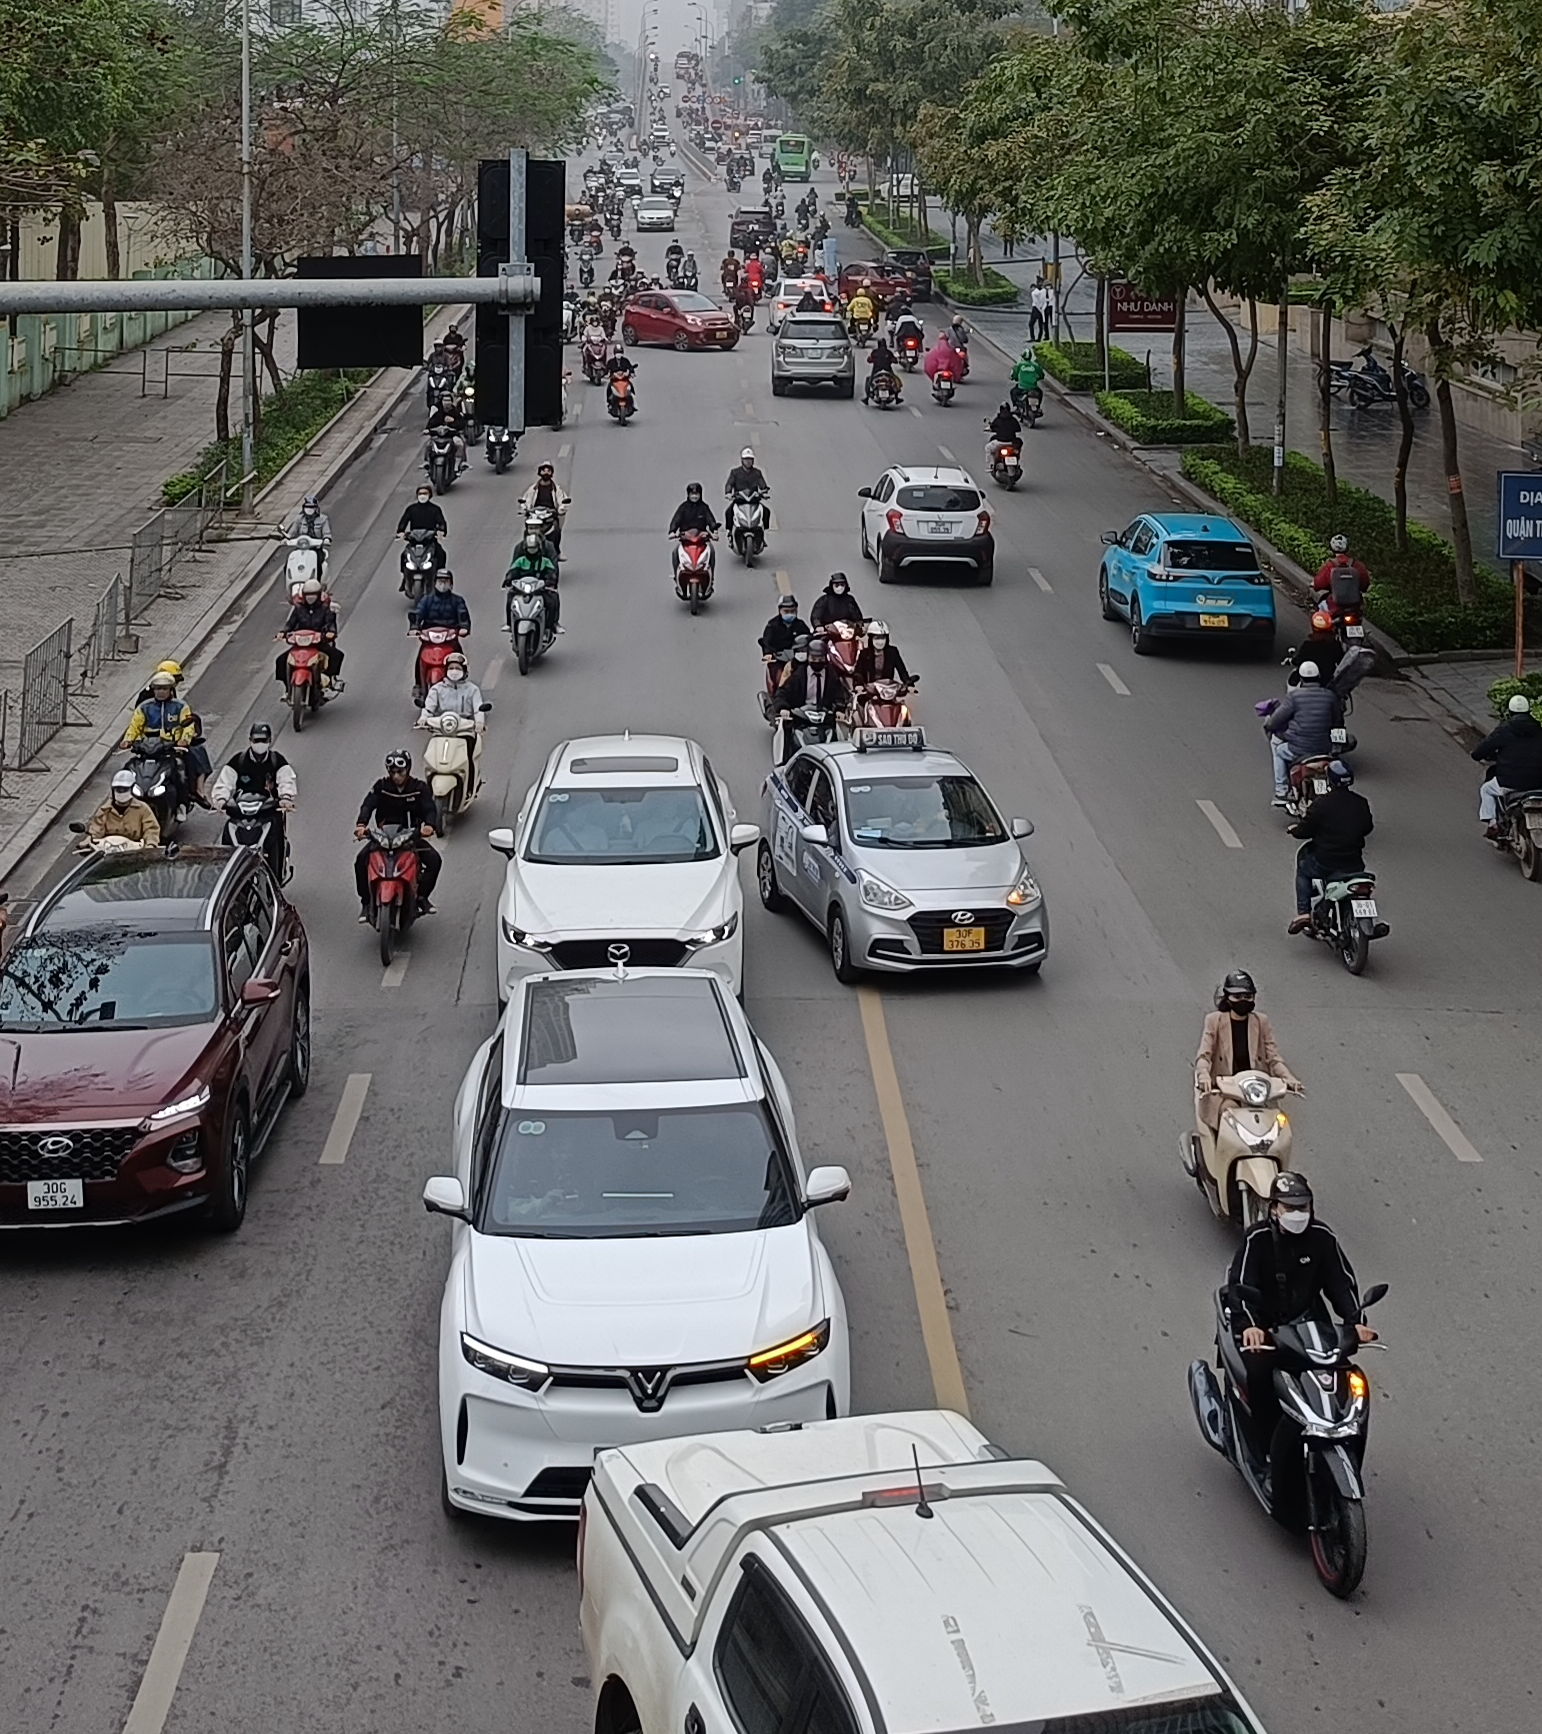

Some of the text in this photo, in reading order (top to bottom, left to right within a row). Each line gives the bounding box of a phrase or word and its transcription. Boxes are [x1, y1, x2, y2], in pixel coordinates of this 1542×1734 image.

[1117, 300, 1173, 312] NHƯ DANH
[1506, 516, 1533, 540] QUẬN
[956, 929, 973, 939] 30F
[43, 1182, 67, 1194] 30G
[34, 1195, 77, 1207] 955.24
